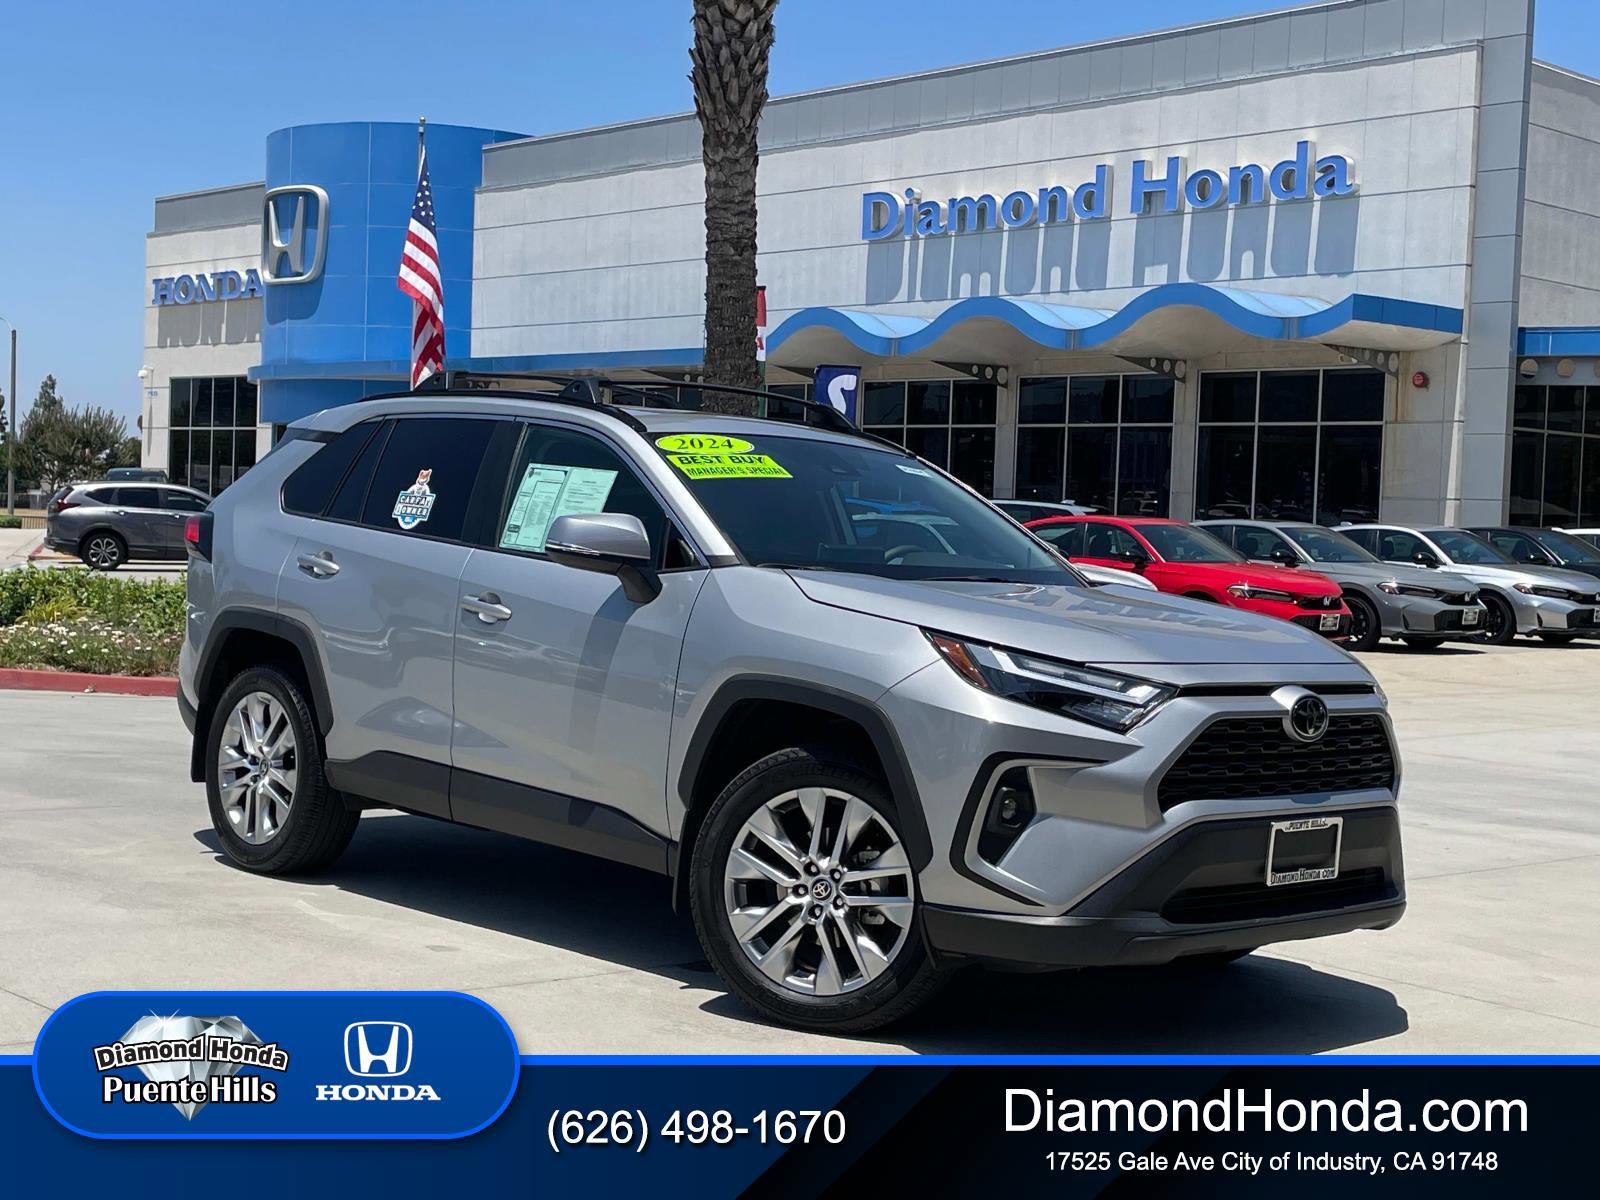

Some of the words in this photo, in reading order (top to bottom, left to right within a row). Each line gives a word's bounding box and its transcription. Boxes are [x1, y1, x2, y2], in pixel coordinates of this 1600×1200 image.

[861, 164, 1112, 241] Diamond
[1130, 140, 1357, 215] Honda
[152, 268, 265, 305] HONDA
[674, 437, 734, 450] 2024
[677, 455, 722, 465] BEST
[729, 455, 765, 464] BUY
